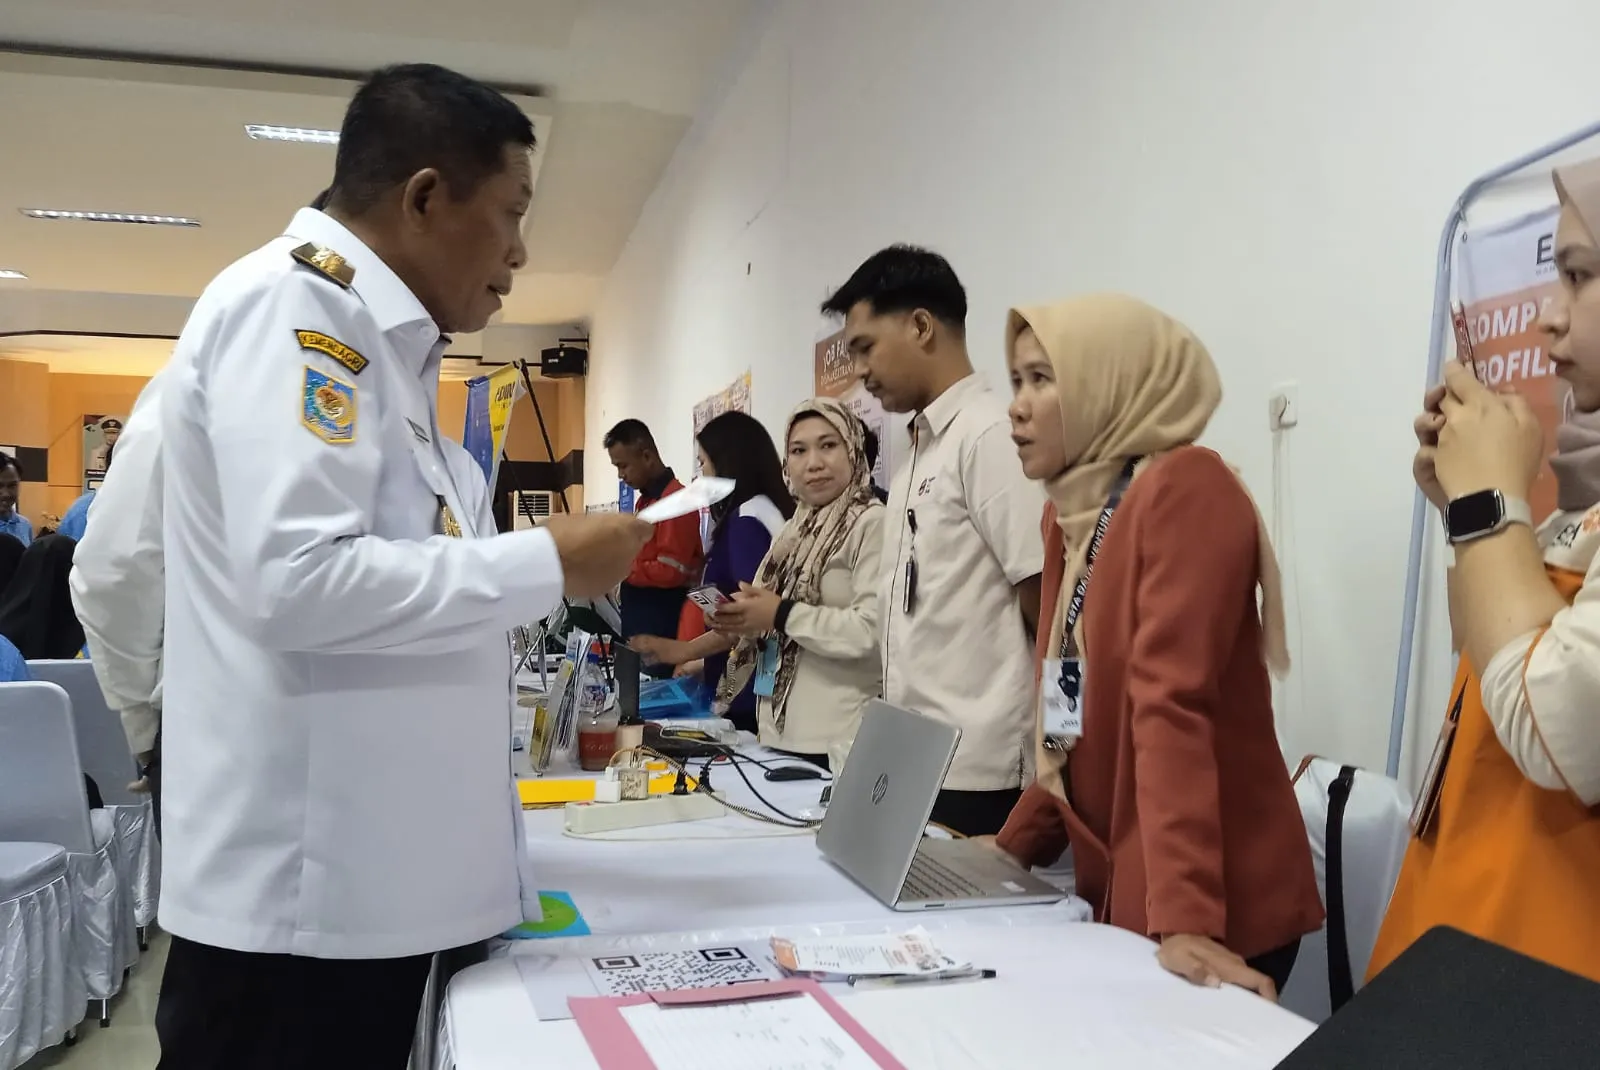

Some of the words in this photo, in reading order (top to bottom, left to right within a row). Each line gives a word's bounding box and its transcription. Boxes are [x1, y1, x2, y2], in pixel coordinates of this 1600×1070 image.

[823, 343, 835, 373] JOB
[837, 339, 851, 361] FAI
[1476, 346, 1557, 387] ROFIL
[1089, 507, 1114, 559] VENTURA
